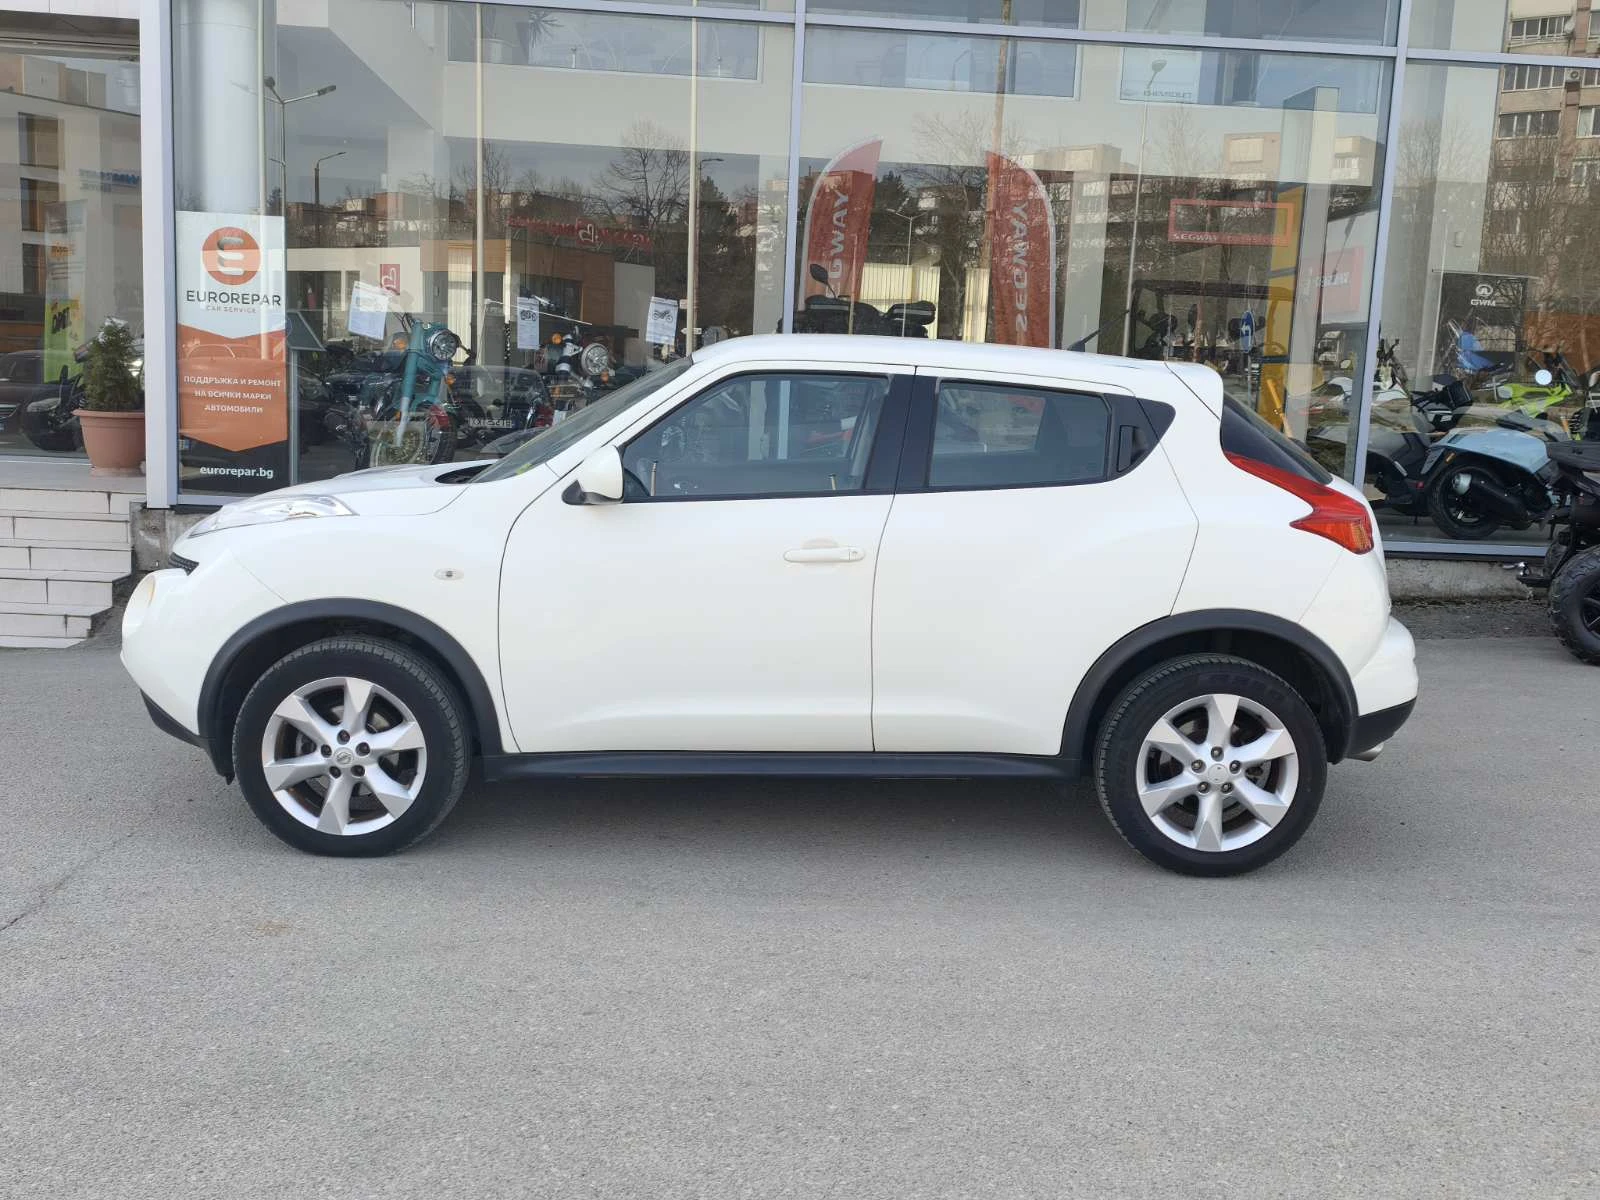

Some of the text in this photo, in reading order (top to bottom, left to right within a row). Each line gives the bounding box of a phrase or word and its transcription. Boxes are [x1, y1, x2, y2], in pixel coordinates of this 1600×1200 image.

[825, 189, 849, 300] EGWAY
[186, 289, 282, 306] EUROREPAR
[1470, 299, 1496, 307] GWM
[206, 304, 257, 314] CAR SERVICE
[183, 375, 239, 386] ПОДДРЪЖКА
[247, 379, 281, 387] РЕМОНТ
[208, 390, 241, 398] ВСИЧКИ
[243, 392, 272, 401] МАРКИ
[205, 404, 263, 413] АВТОМОБИЛИ
[200, 466, 274, 479] eurorepar.bg
